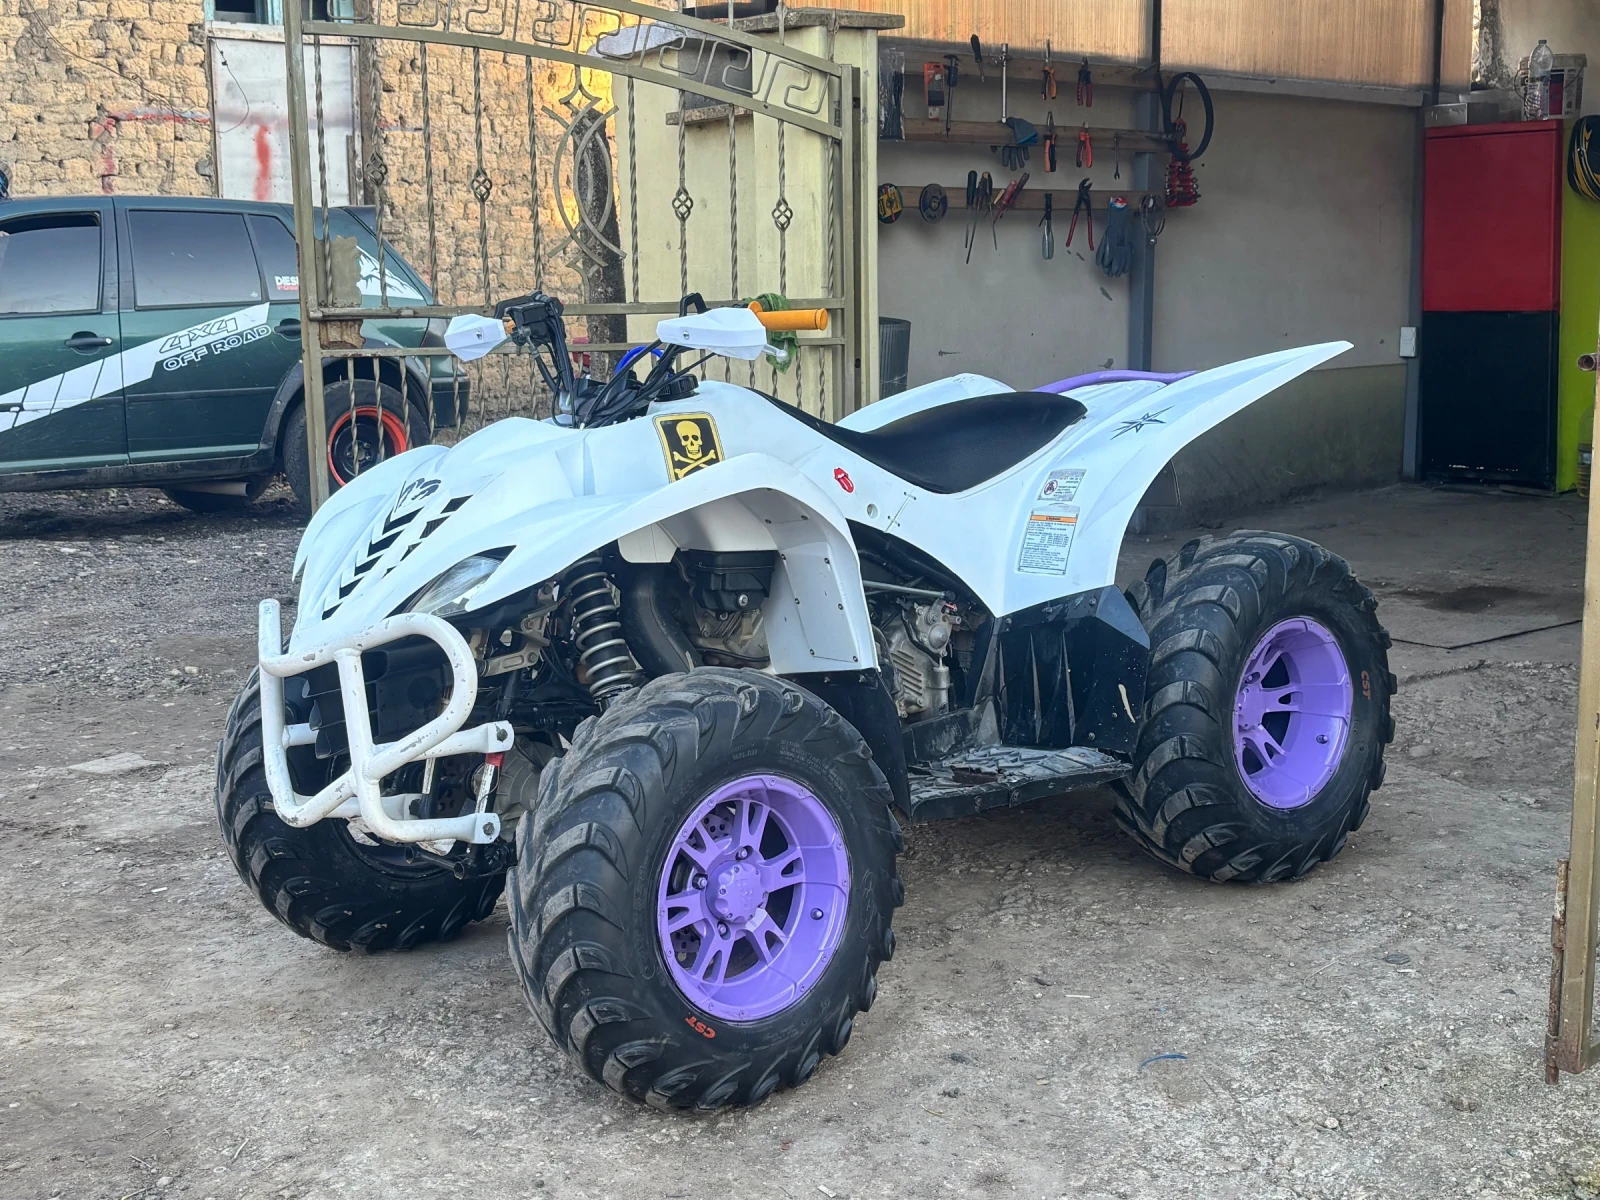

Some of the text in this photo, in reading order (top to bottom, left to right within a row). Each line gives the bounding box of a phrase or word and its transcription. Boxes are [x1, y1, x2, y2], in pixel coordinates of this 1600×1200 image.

[163, 324, 272, 371] OFF ROAD
[1361, 670, 1371, 700] CST
[685, 1015, 716, 1039] CST
